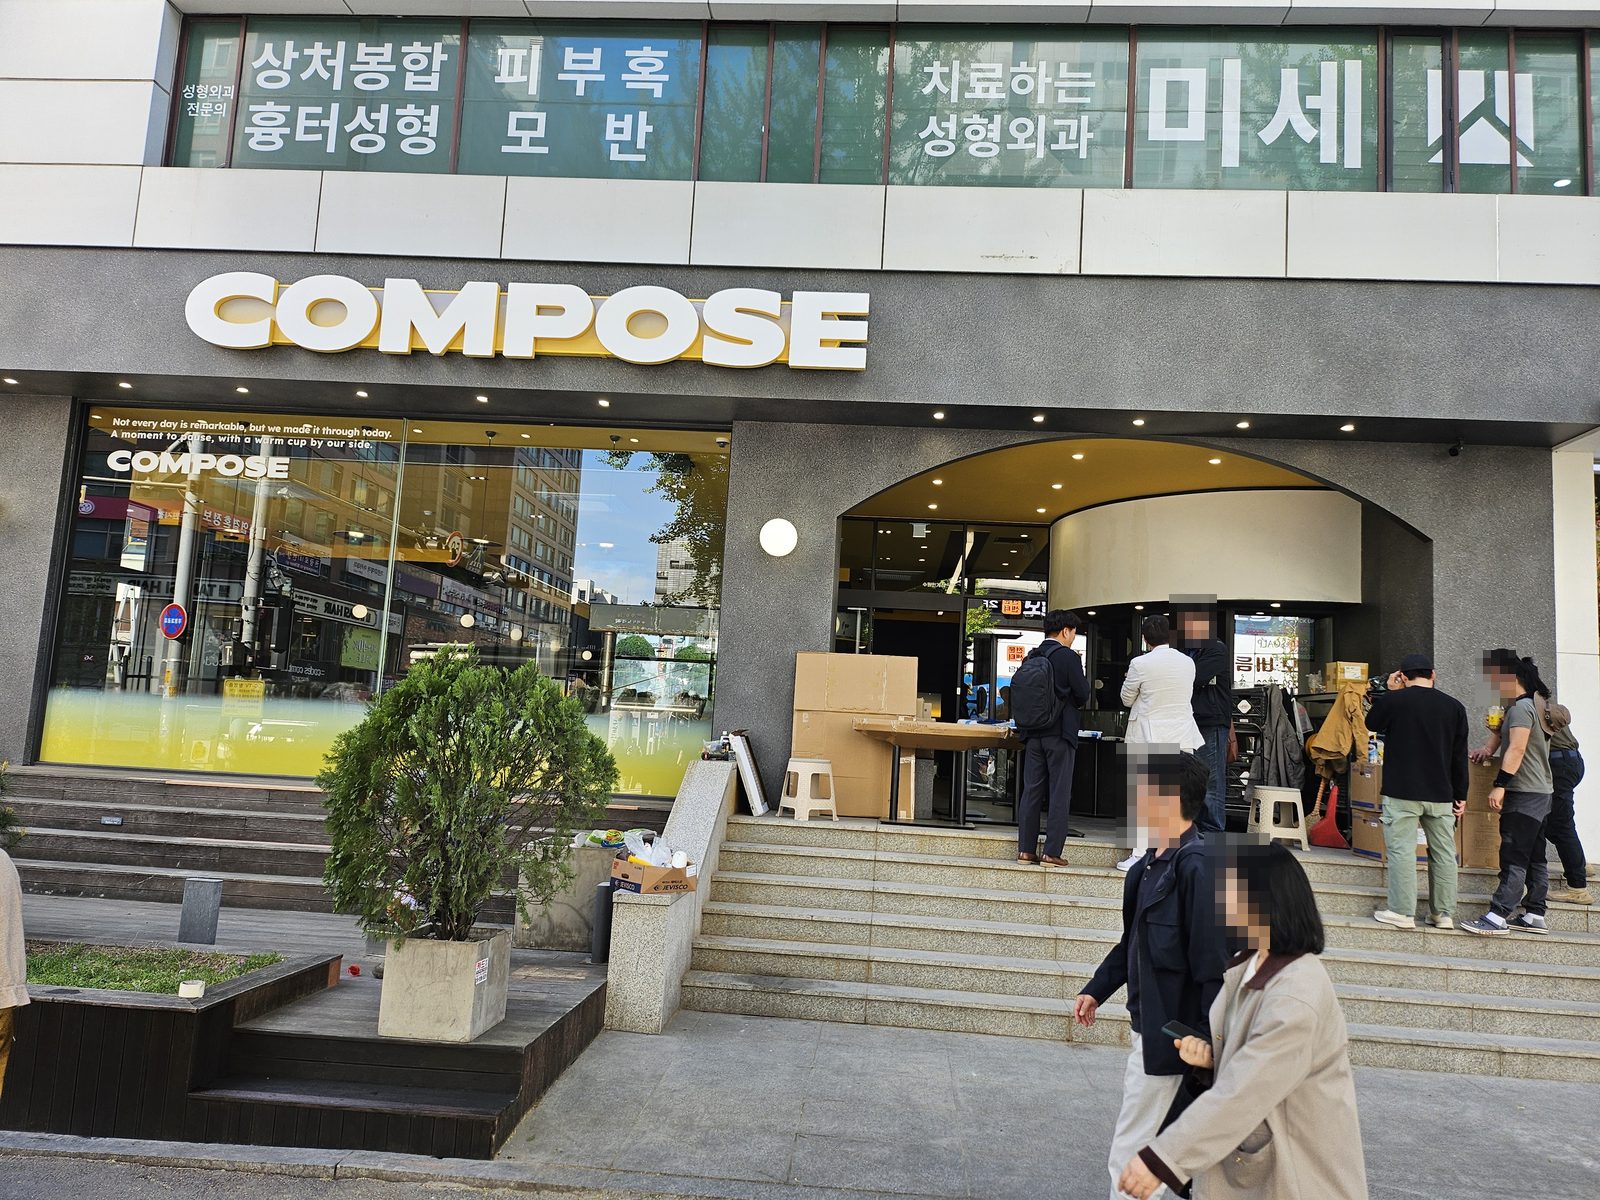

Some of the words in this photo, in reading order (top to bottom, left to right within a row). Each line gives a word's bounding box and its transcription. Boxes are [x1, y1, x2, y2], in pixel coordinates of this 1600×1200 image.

[250, 41, 448, 92] 상처봉합
[922, 59, 1096, 106] 치료하는
[186, 102, 227, 117] 전문의
[243, 101, 439, 155] 흉터성형
[1148, 58, 1361, 169] 미세
[918, 115, 1094, 160] 성형외과
[185, 272, 870, 370] COMPOSE
[110, 430, 118, 438] A
[121, 431, 163, 440] moment
[166, 432, 177, 441] to
[180, 433, 215, 444] pause,
[218, 434, 241, 443] with
[244, 436, 251, 444] a
[255, 437, 284, 445] warm
[287, 438, 306, 449] cup
[310, 437, 323, 449] by
[327, 440, 345, 448] our
[348, 439, 373, 449] side.
[113, 418, 130, 427] Not
[131, 420, 158, 430] every
[160, 420, 178, 430] day
[180, 420, 188, 429] is
[190, 421, 247, 433] remarkable,
[250, 423, 266, 432] but
[268, 425, 281, 433] we
[284, 424, 311, 434] made
[313, 425, 321, 435] it
[322, 426, 360, 438] through
[362, 428, 392, 439] today.
[107, 450, 290, 479] COMPOSE
